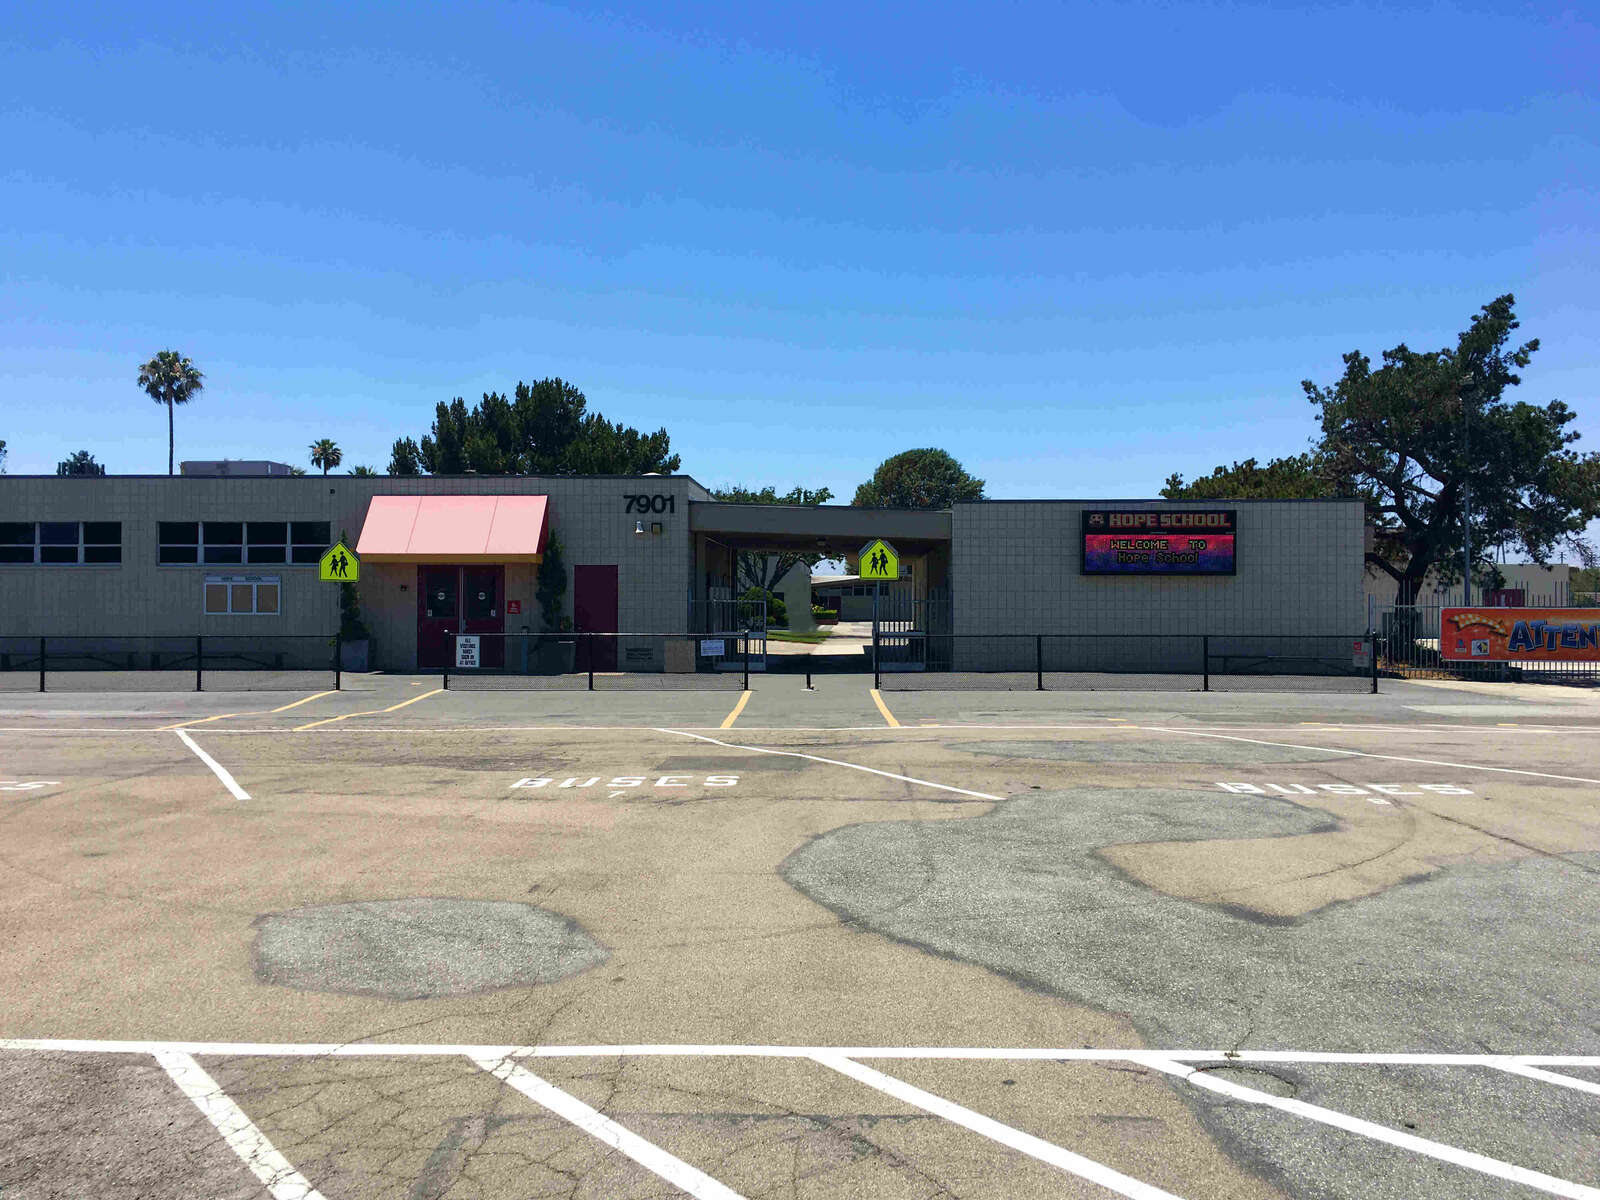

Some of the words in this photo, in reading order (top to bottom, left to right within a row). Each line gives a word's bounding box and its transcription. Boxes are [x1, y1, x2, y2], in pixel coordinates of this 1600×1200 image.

[623, 494, 675, 514] 7901
[1109, 513, 1158, 528] HOPE
[1160, 513, 1231, 528] SCHOOL
[1110, 540, 1168, 550] WELCOME
[1189, 540, 1206, 550] TO
[1118, 552, 1150, 563] Hope
[1156, 551, 1199, 563] School
[1507, 619, 1600, 652] ATTEN
[509, 775, 741, 788] BUSES
[608, 790, 626, 798] 7
[1215, 782, 1475, 795] BUSES
